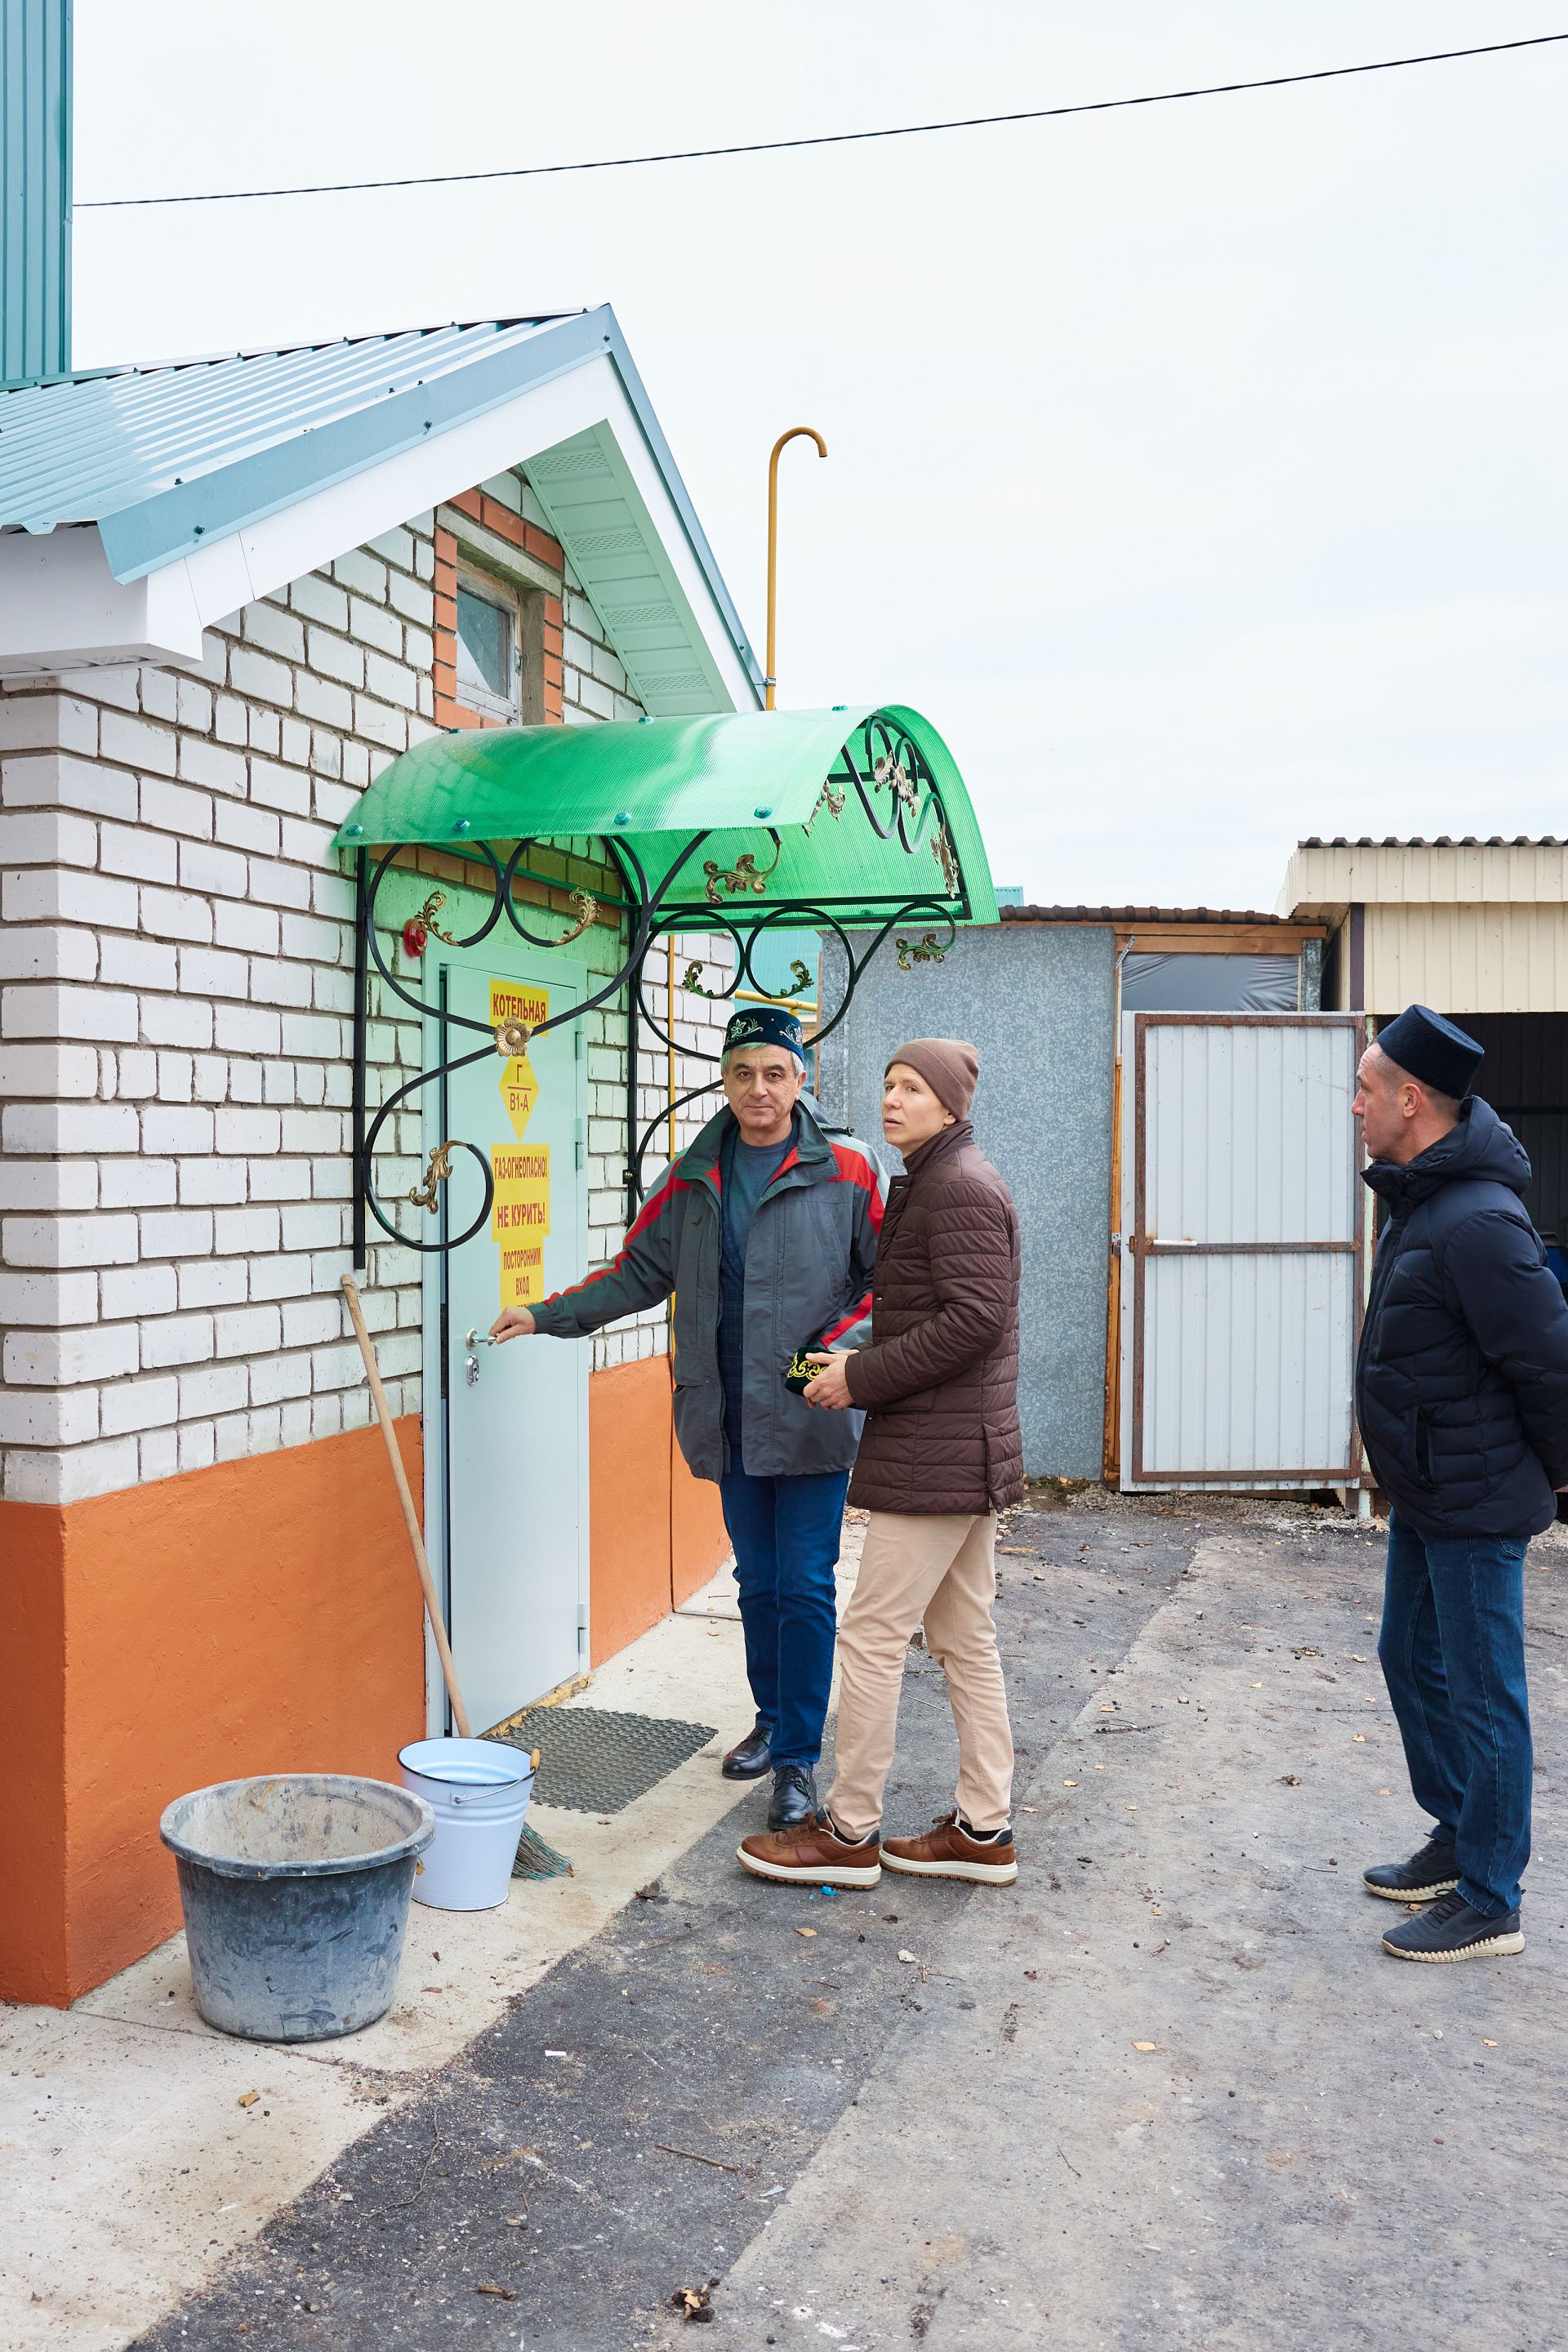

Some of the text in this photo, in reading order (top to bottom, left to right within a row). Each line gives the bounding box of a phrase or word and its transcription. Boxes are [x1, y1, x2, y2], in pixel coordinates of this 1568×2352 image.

[492, 992, 546, 1023] КОТЕЛЬНАЯ
[516, 1063, 523, 1083] Г
[494, 1156, 547, 1180] ГАЗ-ОГНЕОПАСНО!
[497, 1202, 546, 1228] НЕ КУРИТЬ!
[503, 1247, 541, 1271] ПОСТОРОННИМ
[515, 1276, 530, 1298] ВХОД
